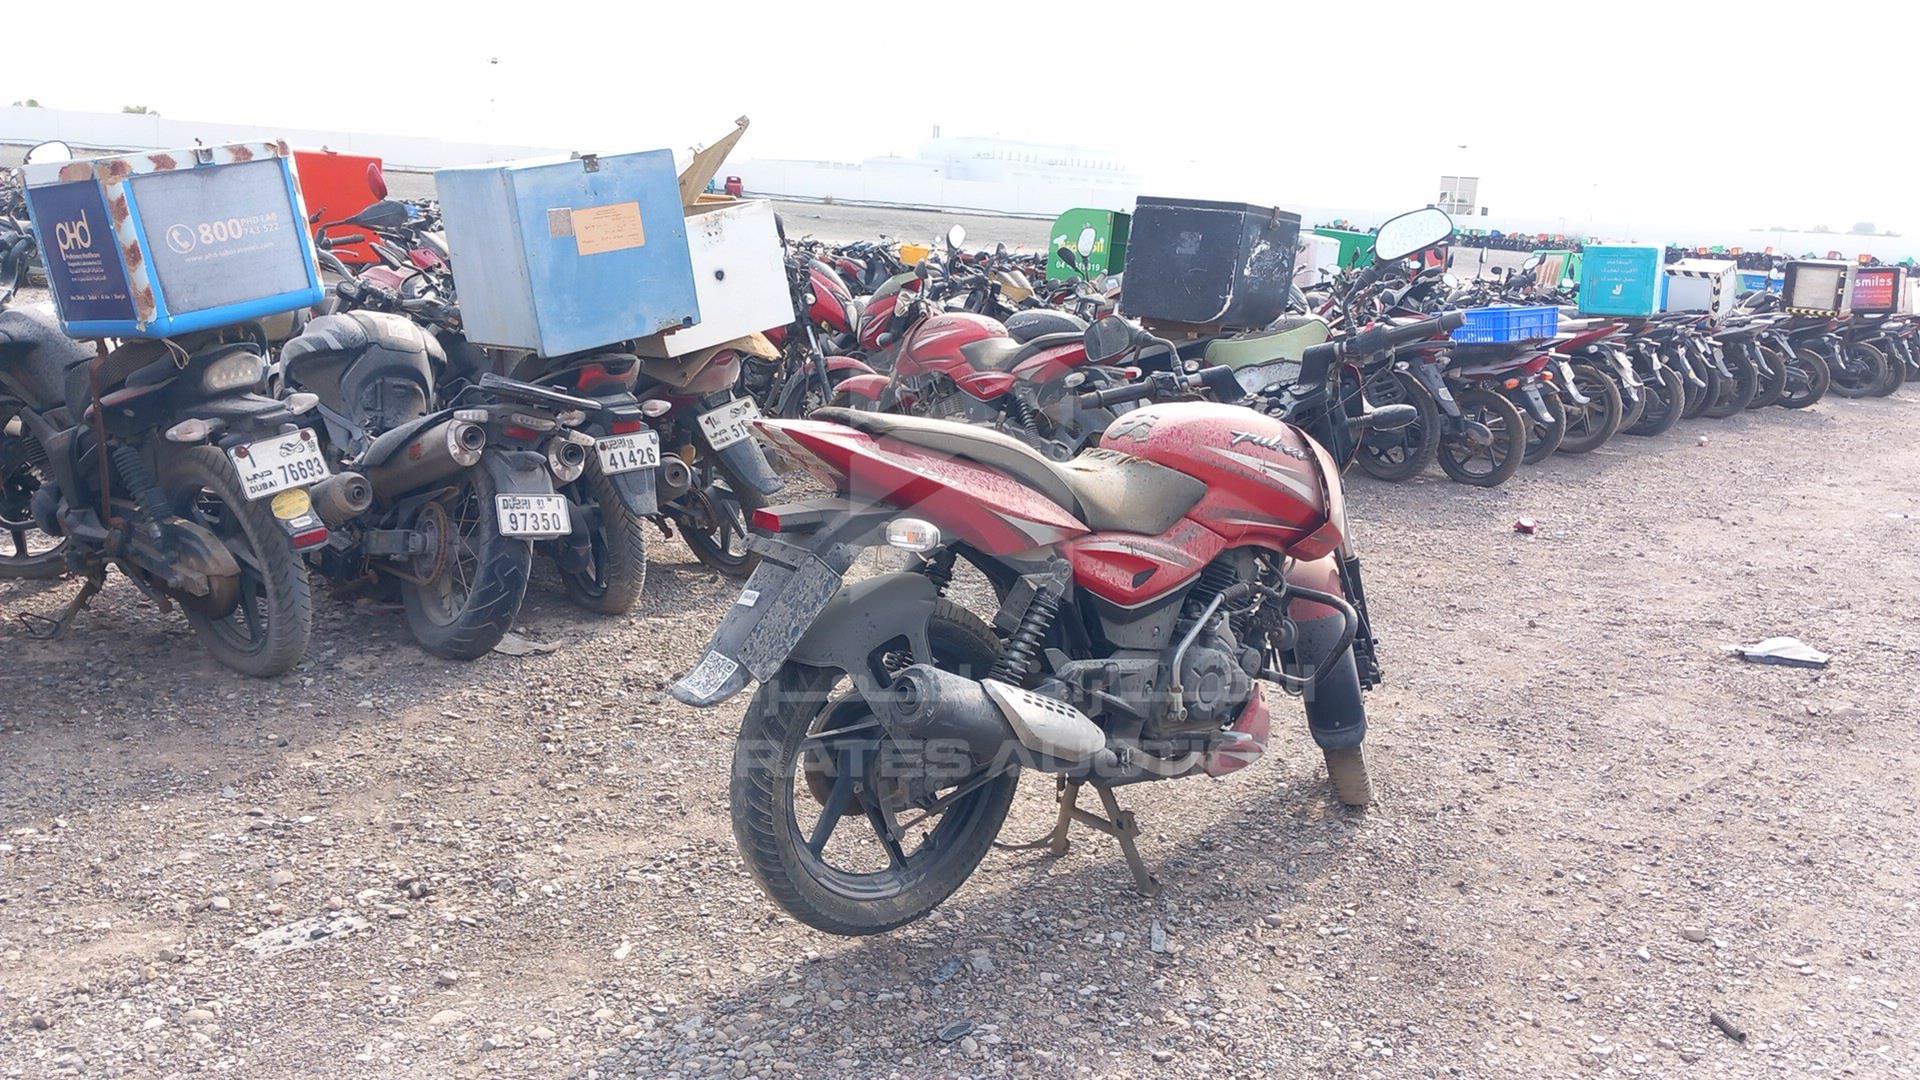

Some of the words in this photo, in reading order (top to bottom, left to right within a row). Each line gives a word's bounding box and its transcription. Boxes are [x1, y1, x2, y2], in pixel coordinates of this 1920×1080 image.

[198, 218, 242, 245] 800
[1855, 275, 1893, 287] smiles
[609, 447, 656, 469] 41426
[278, 456, 324, 485] 76693
[249, 479, 278, 494] DUBAI
[509, 512, 561, 532] 97350
